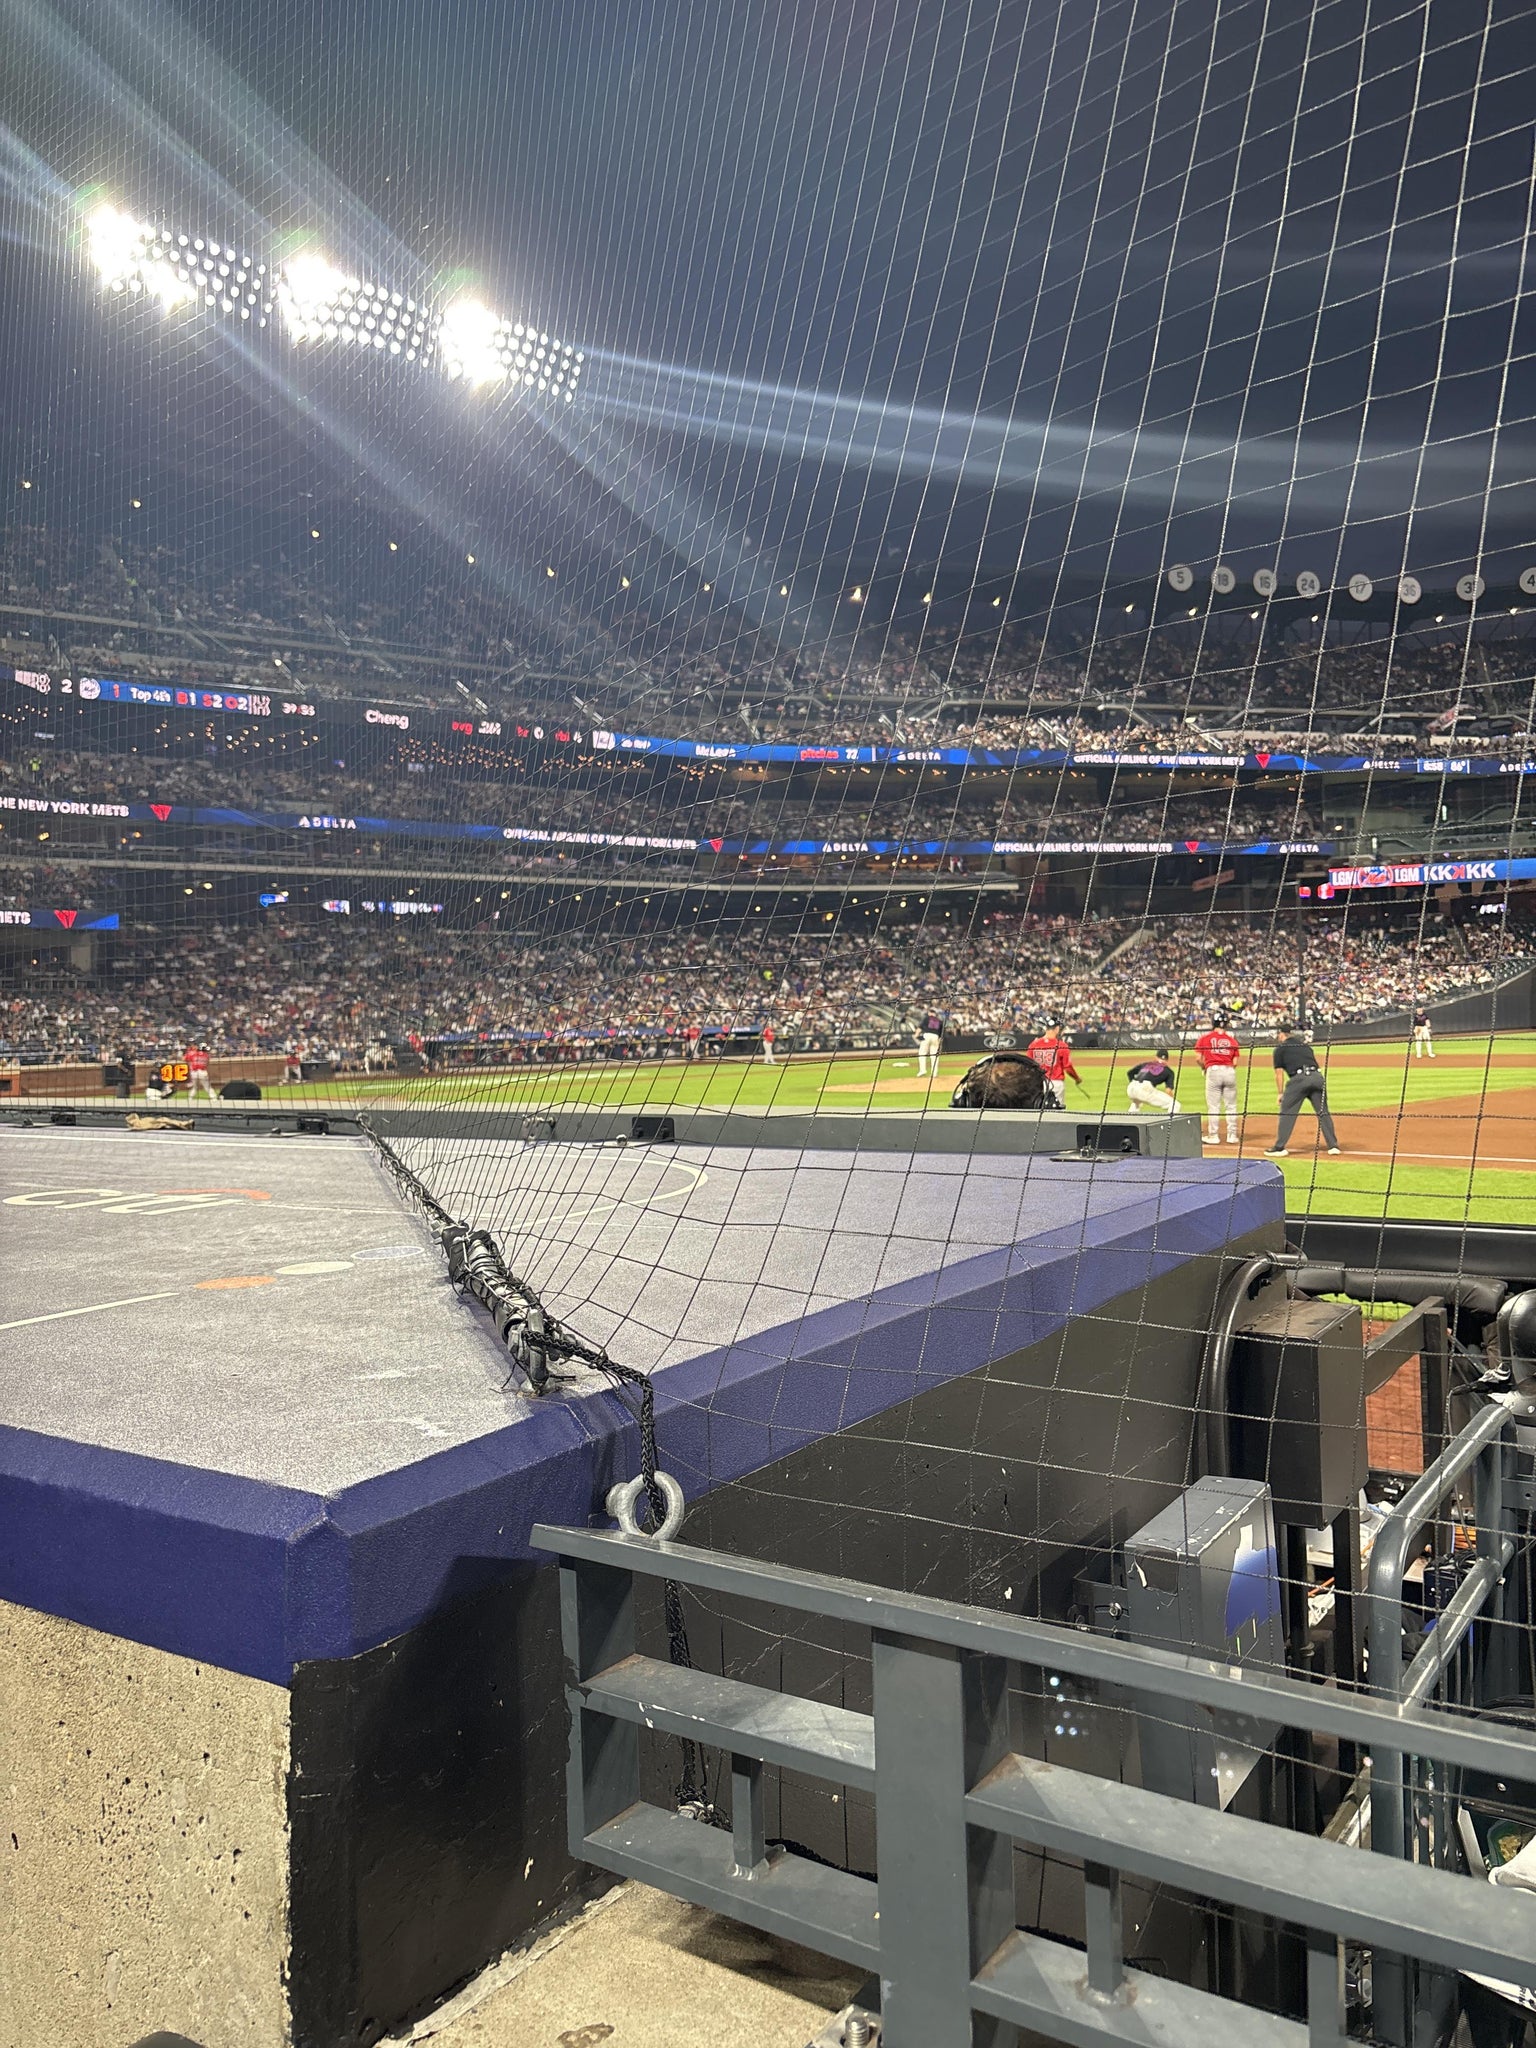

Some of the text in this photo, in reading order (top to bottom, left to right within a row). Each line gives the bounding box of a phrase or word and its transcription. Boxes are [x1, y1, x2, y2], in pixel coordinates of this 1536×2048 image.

[1176, 571, 1185, 584] 5
[1301, 578, 1316, 592] 24
[1464, 580, 1477, 596] 3
[61, 678, 73, 694] 2
[130, 687, 152, 703] Top
[365, 709, 409, 730] Cheng
[907, 752, 942, 761] DELTA
[1073, 754, 1113, 764] OFFICIAL
[1115, 755, 1147, 765] AIRLINE
[1149, 755, 1160, 765] OF
[1178, 756, 1198, 766] NEW
[1198, 757, 1221, 767] YORK
[1221, 757, 1245, 767] METS
[18, 798, 49, 813] NEW
[51, 801, 90, 816] YORK
[92, 804, 130, 818] METS
[312, 817, 358, 830] DELTA
[833, 842, 869, 852] DELTA
[994, 842, 1173, 854] OFFICIAL AIRLINE OF THE NEW YORK METS
[1290, 844, 1320, 853] DELTA
[1395, 867, 1420, 883] LGM
